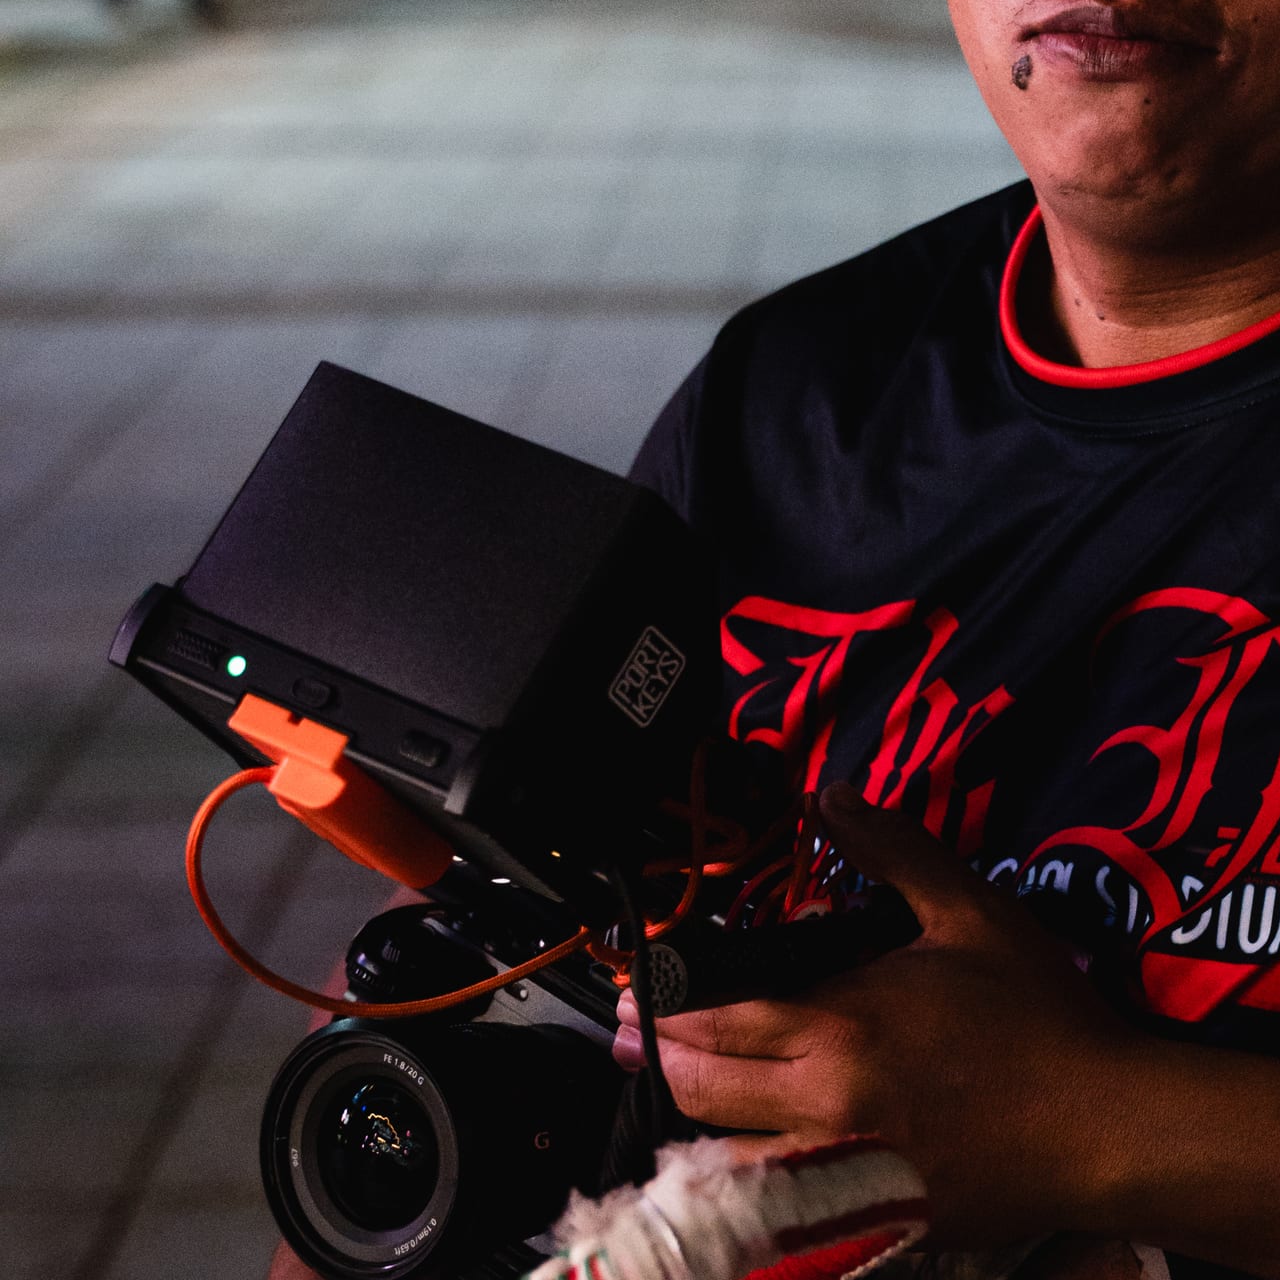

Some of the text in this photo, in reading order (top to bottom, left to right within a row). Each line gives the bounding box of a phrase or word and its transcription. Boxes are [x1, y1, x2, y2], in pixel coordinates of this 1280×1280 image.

[615, 634, 661, 703] PORT
[632, 651, 679, 719] KEYS
[720, 595, 1016, 856] The
[383, 1053, 393, 1064] FE
[394, 1058, 418, 1079] 1.8/20
[533, 1130, 550, 1150] G
